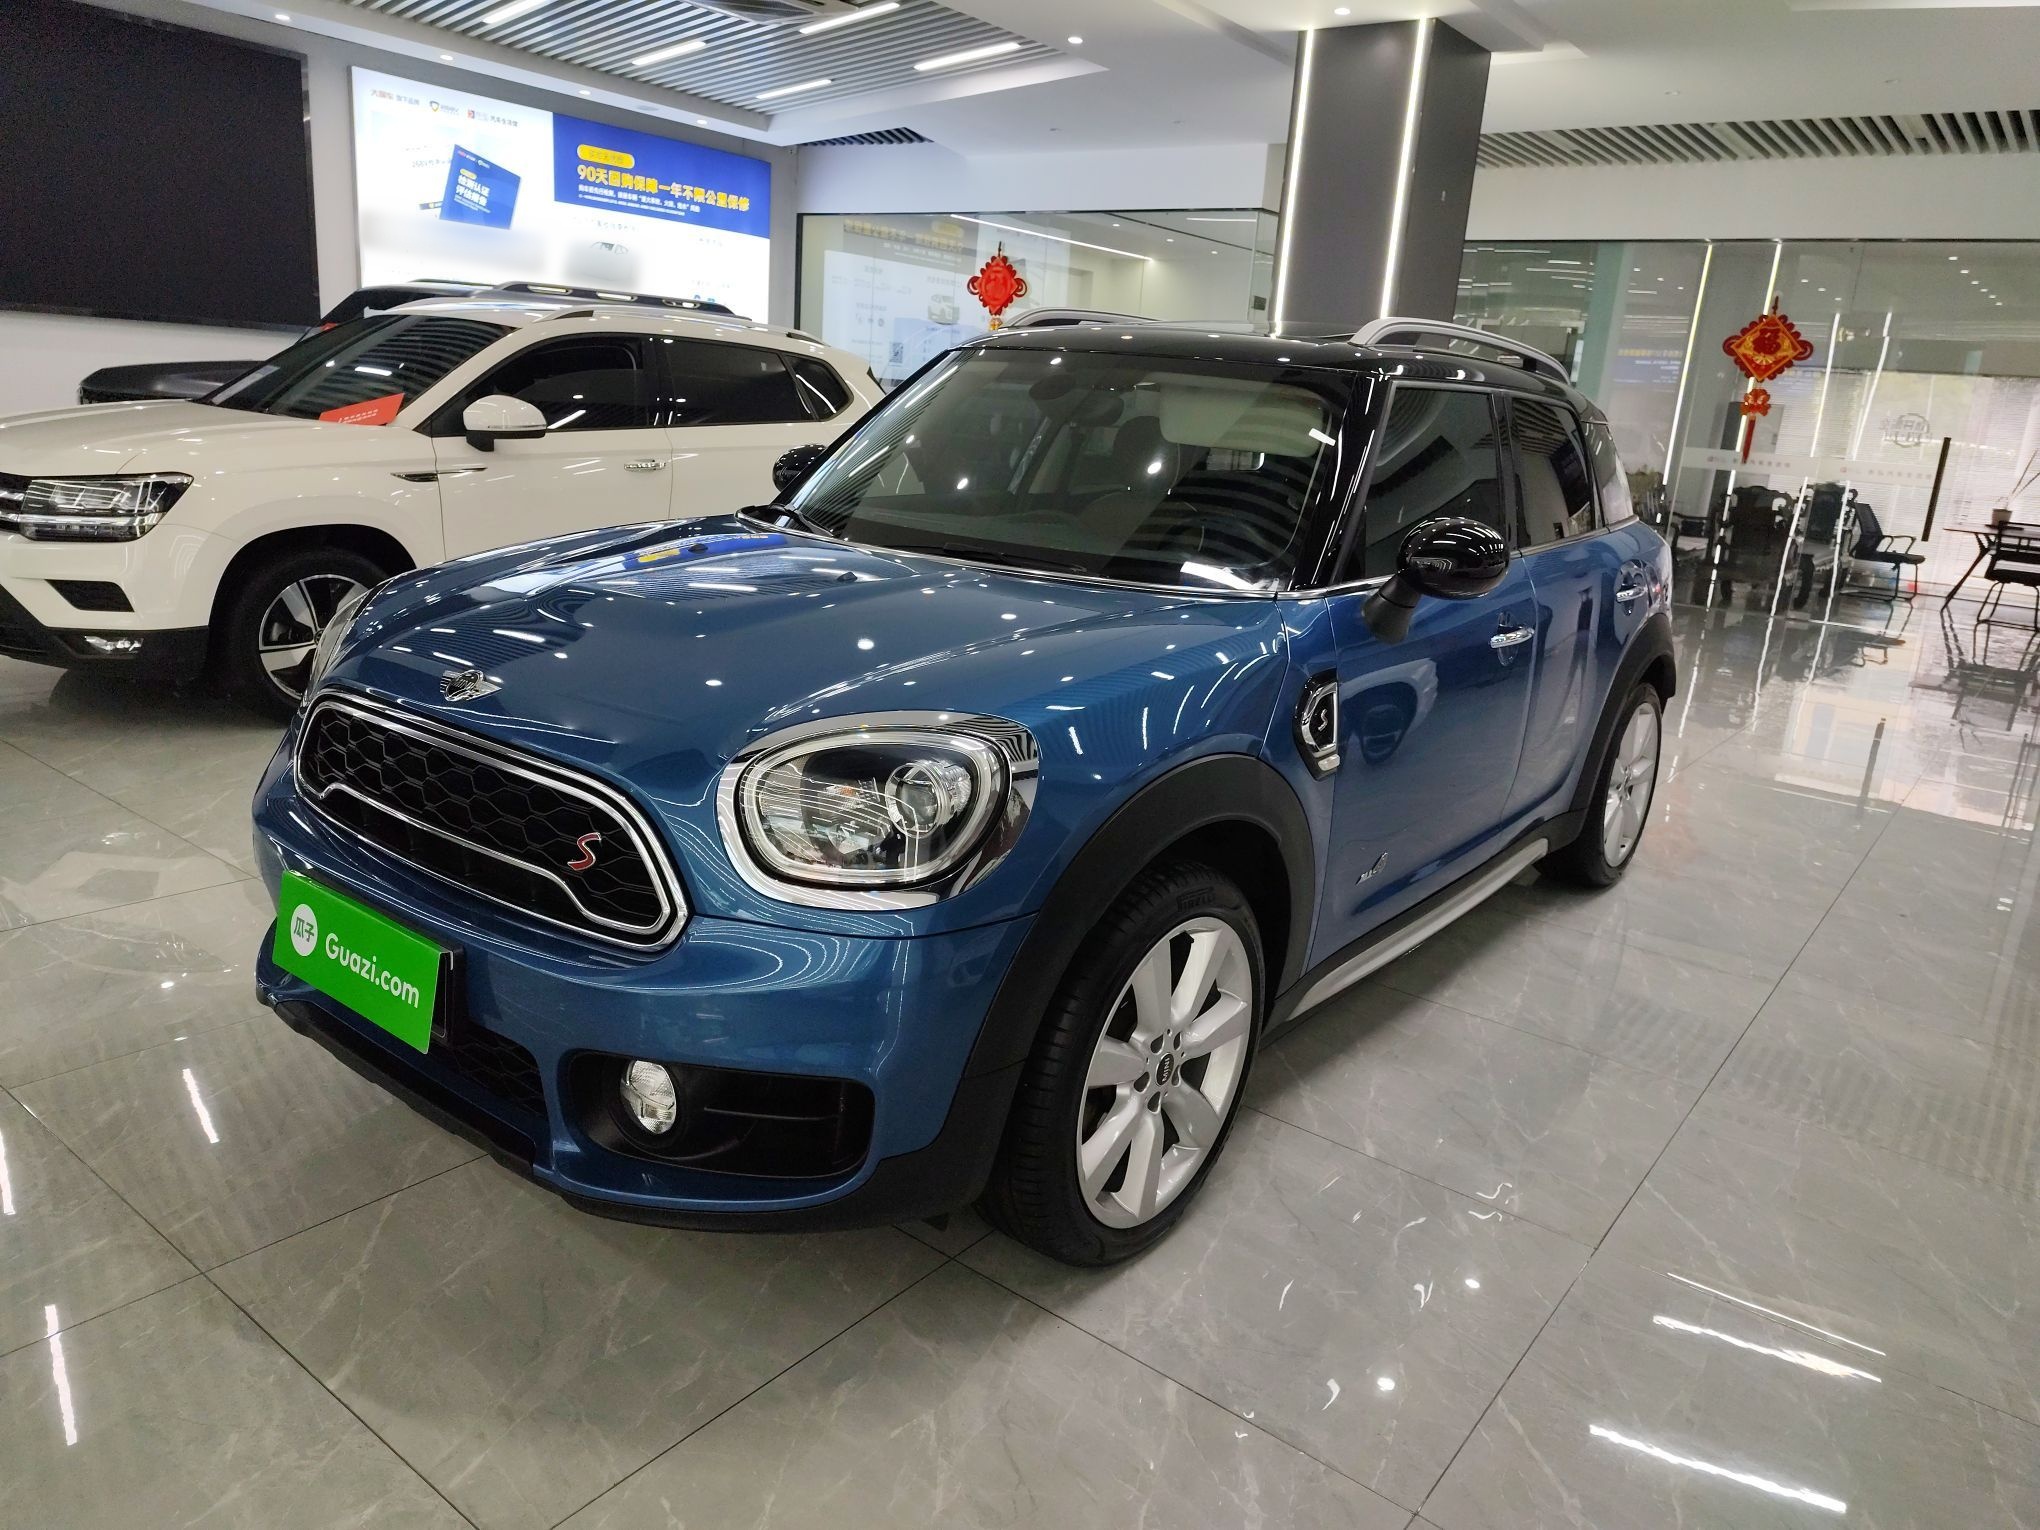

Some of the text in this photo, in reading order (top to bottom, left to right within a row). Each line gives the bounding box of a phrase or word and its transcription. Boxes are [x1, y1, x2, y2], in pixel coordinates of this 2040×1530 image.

[1317, 708, 1329, 732] S
[567, 832, 602, 871] S
[292, 919, 316, 946] 瓜子
[324, 932, 420, 1010] Guazi.com
[1160, 1057, 1171, 1082] MINI
